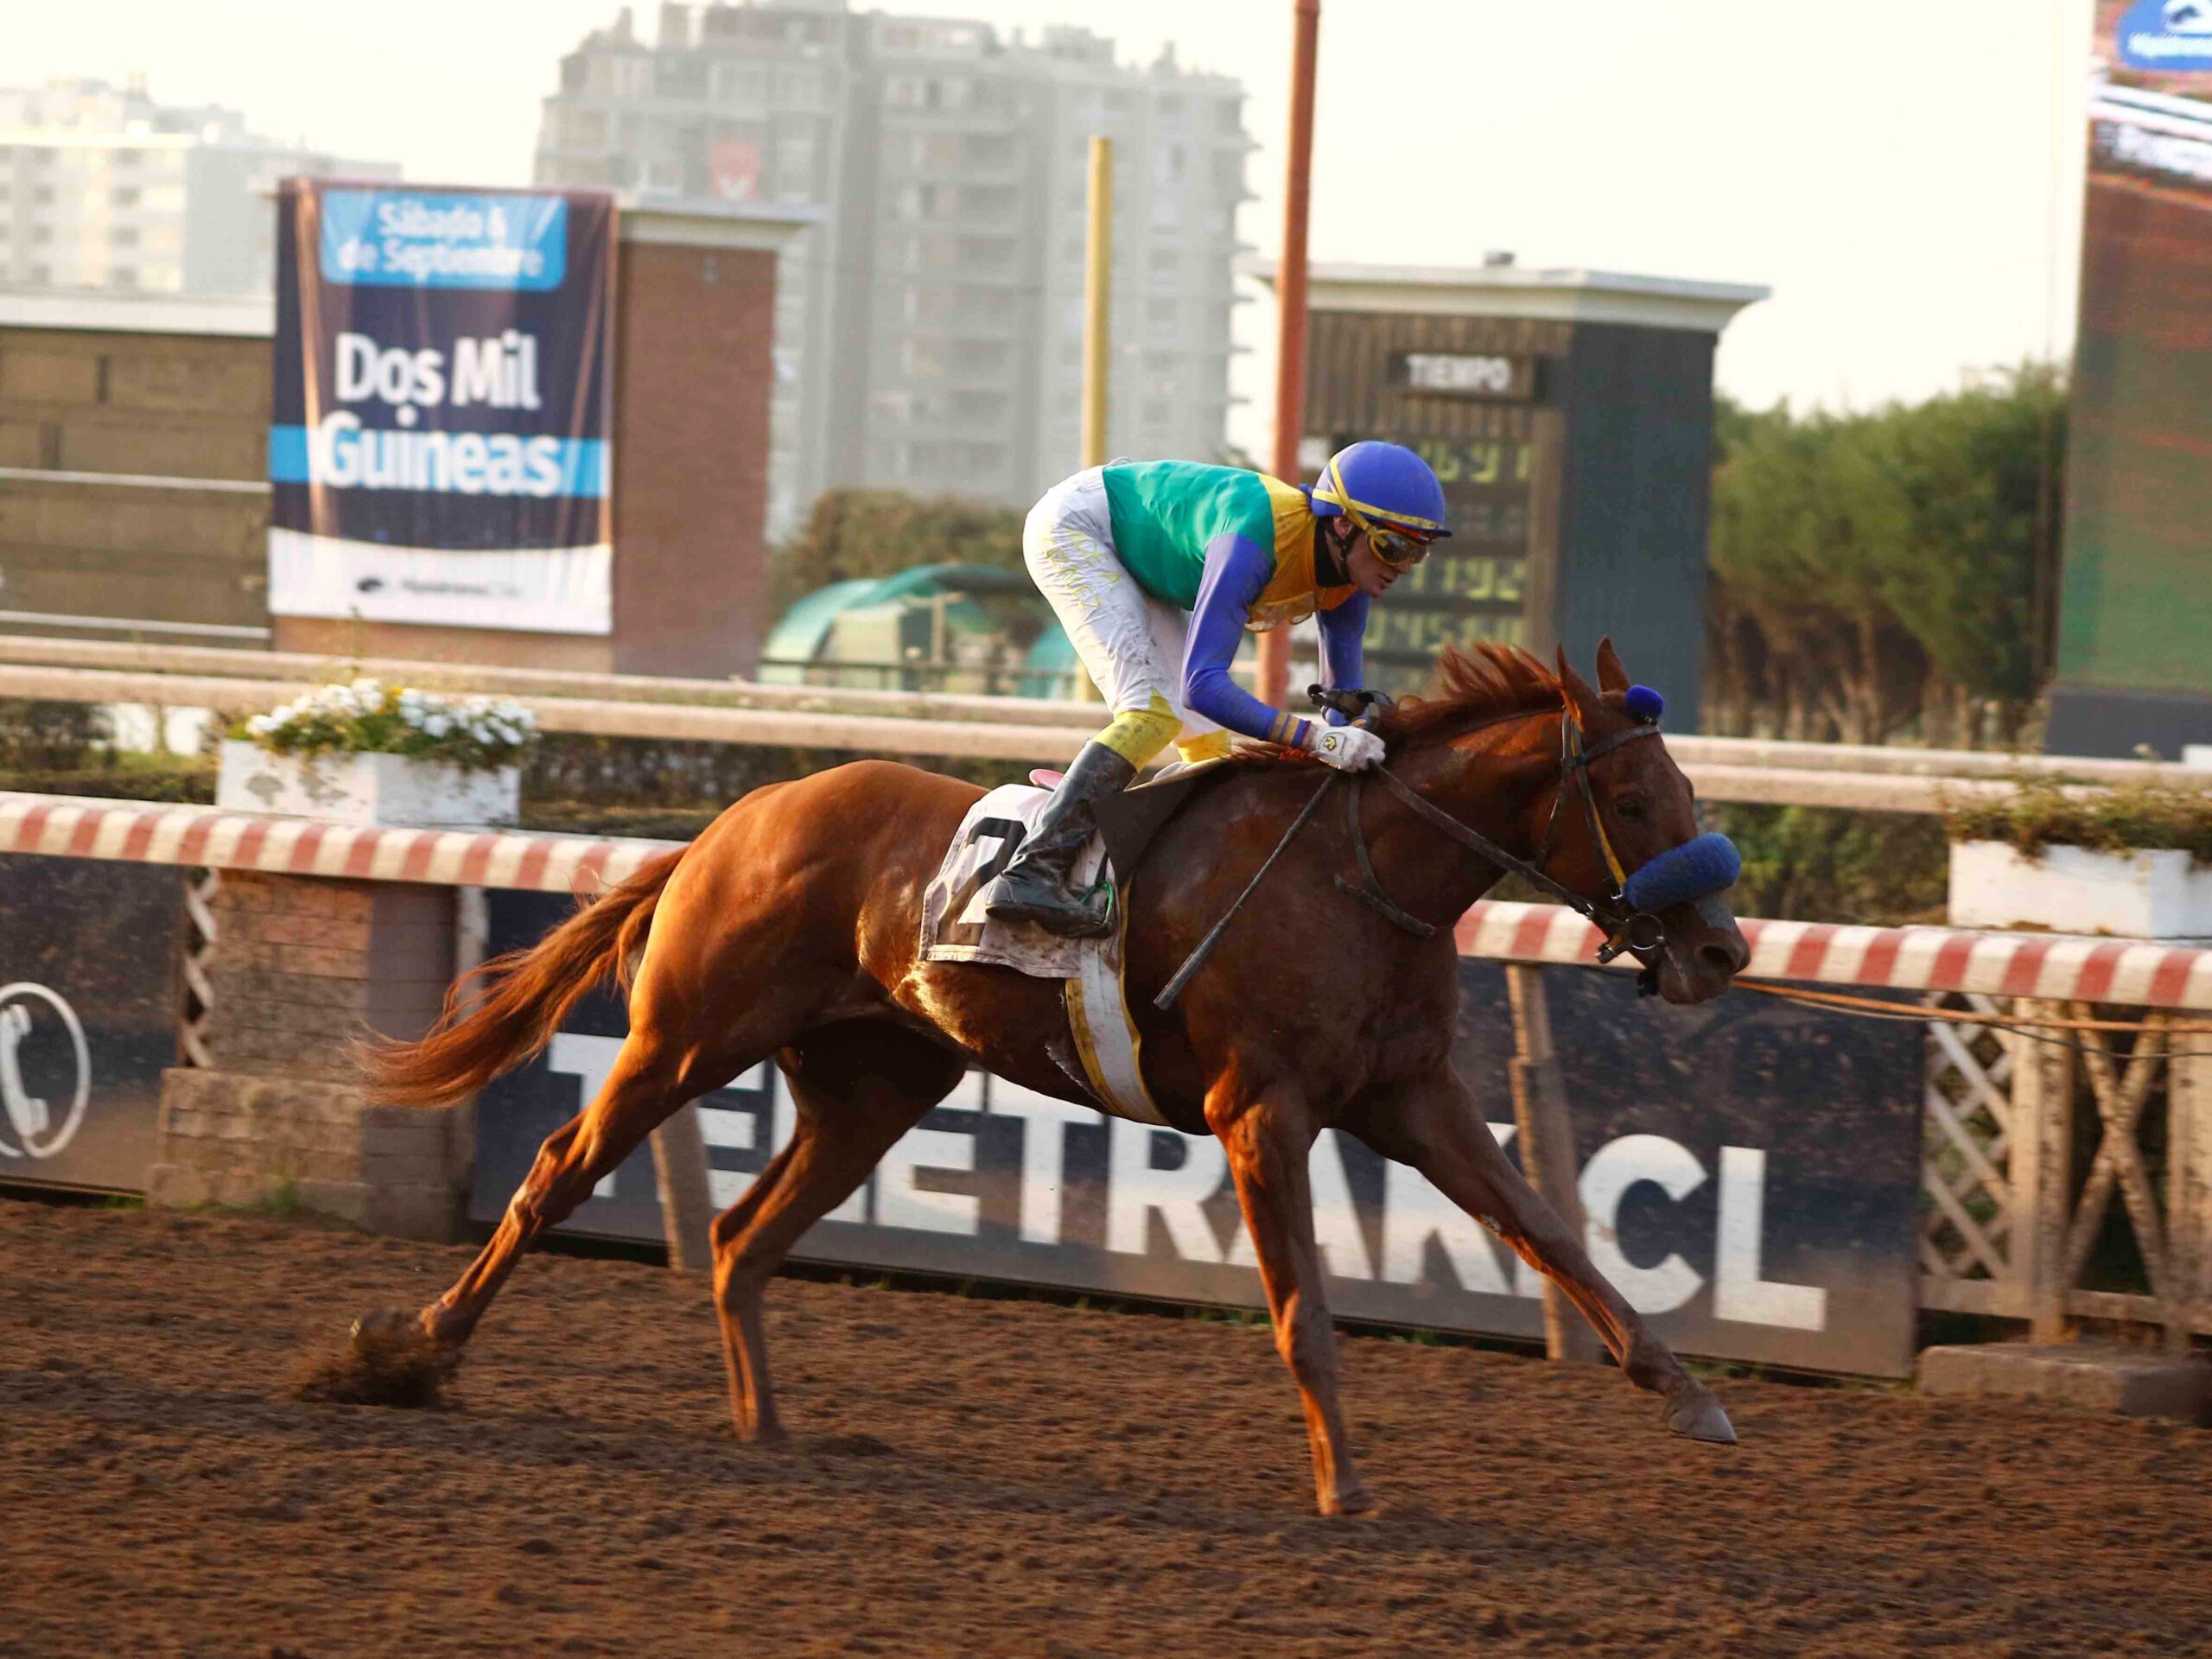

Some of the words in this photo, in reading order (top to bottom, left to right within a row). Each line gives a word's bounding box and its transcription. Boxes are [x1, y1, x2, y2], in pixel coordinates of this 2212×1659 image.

[335, 332, 446, 408] Dos
[451, 328, 543, 410] Mil
[1406, 353, 1510, 391] TIEMPO
[317, 404, 562, 497] Guineas
